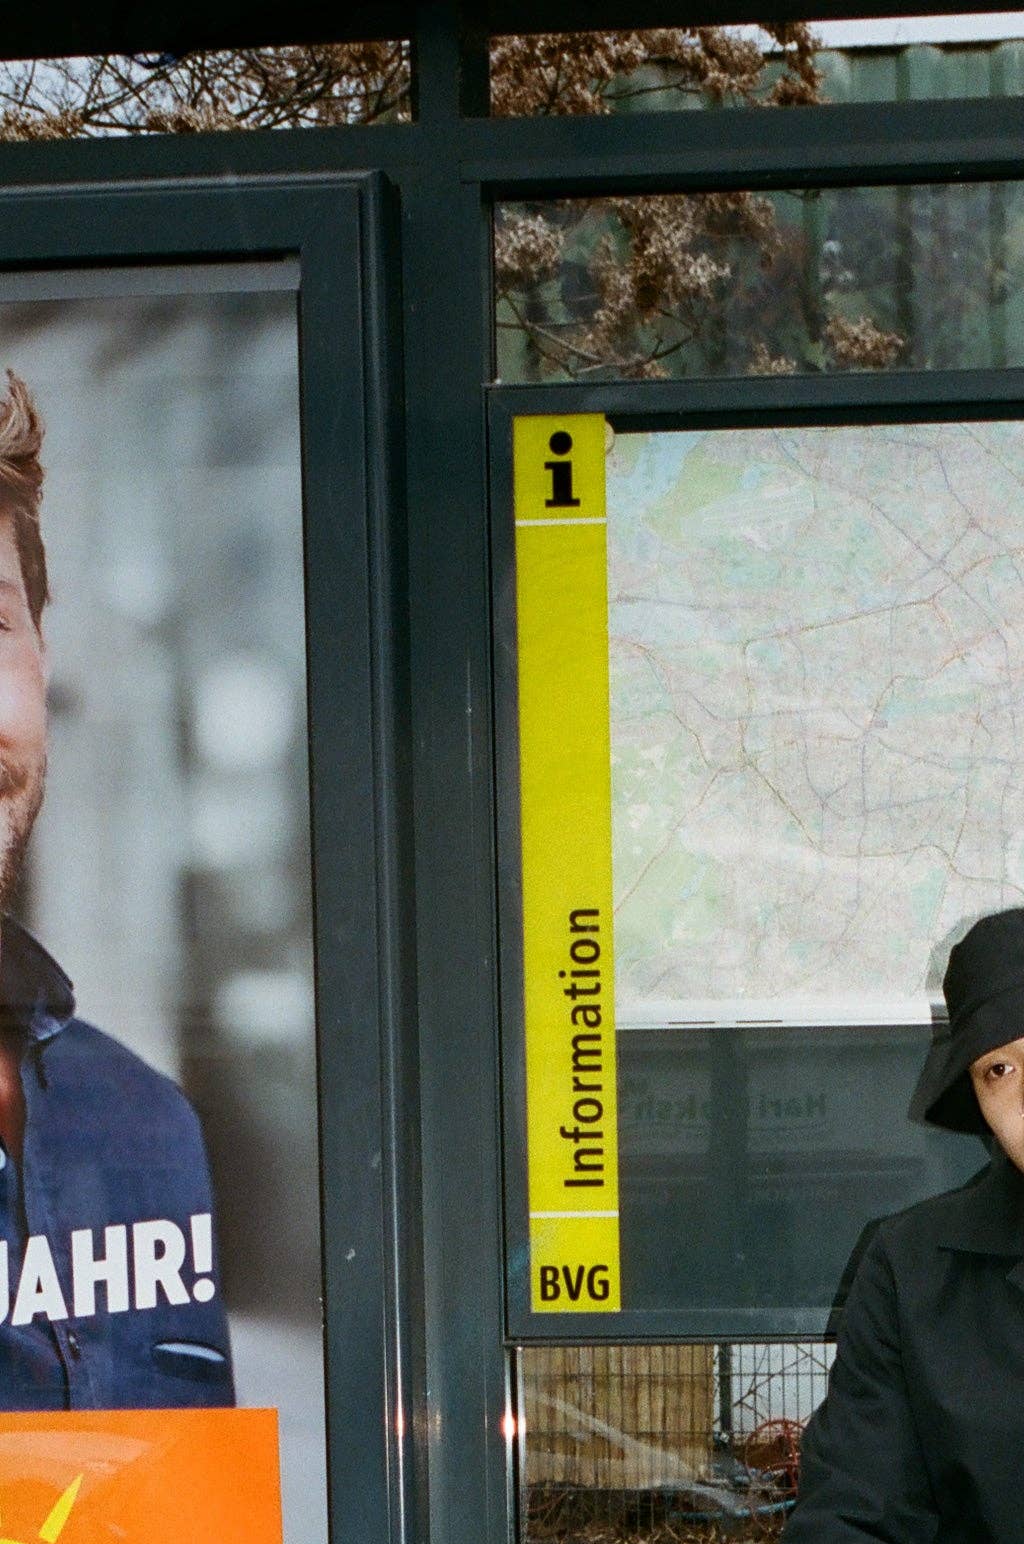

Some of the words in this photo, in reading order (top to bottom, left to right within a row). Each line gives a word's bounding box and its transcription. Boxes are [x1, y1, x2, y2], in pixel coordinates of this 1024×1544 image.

[544, 430, 581, 508] i
[559, 907, 605, 1188] Information
[539, 1264, 610, 1302] BVG
